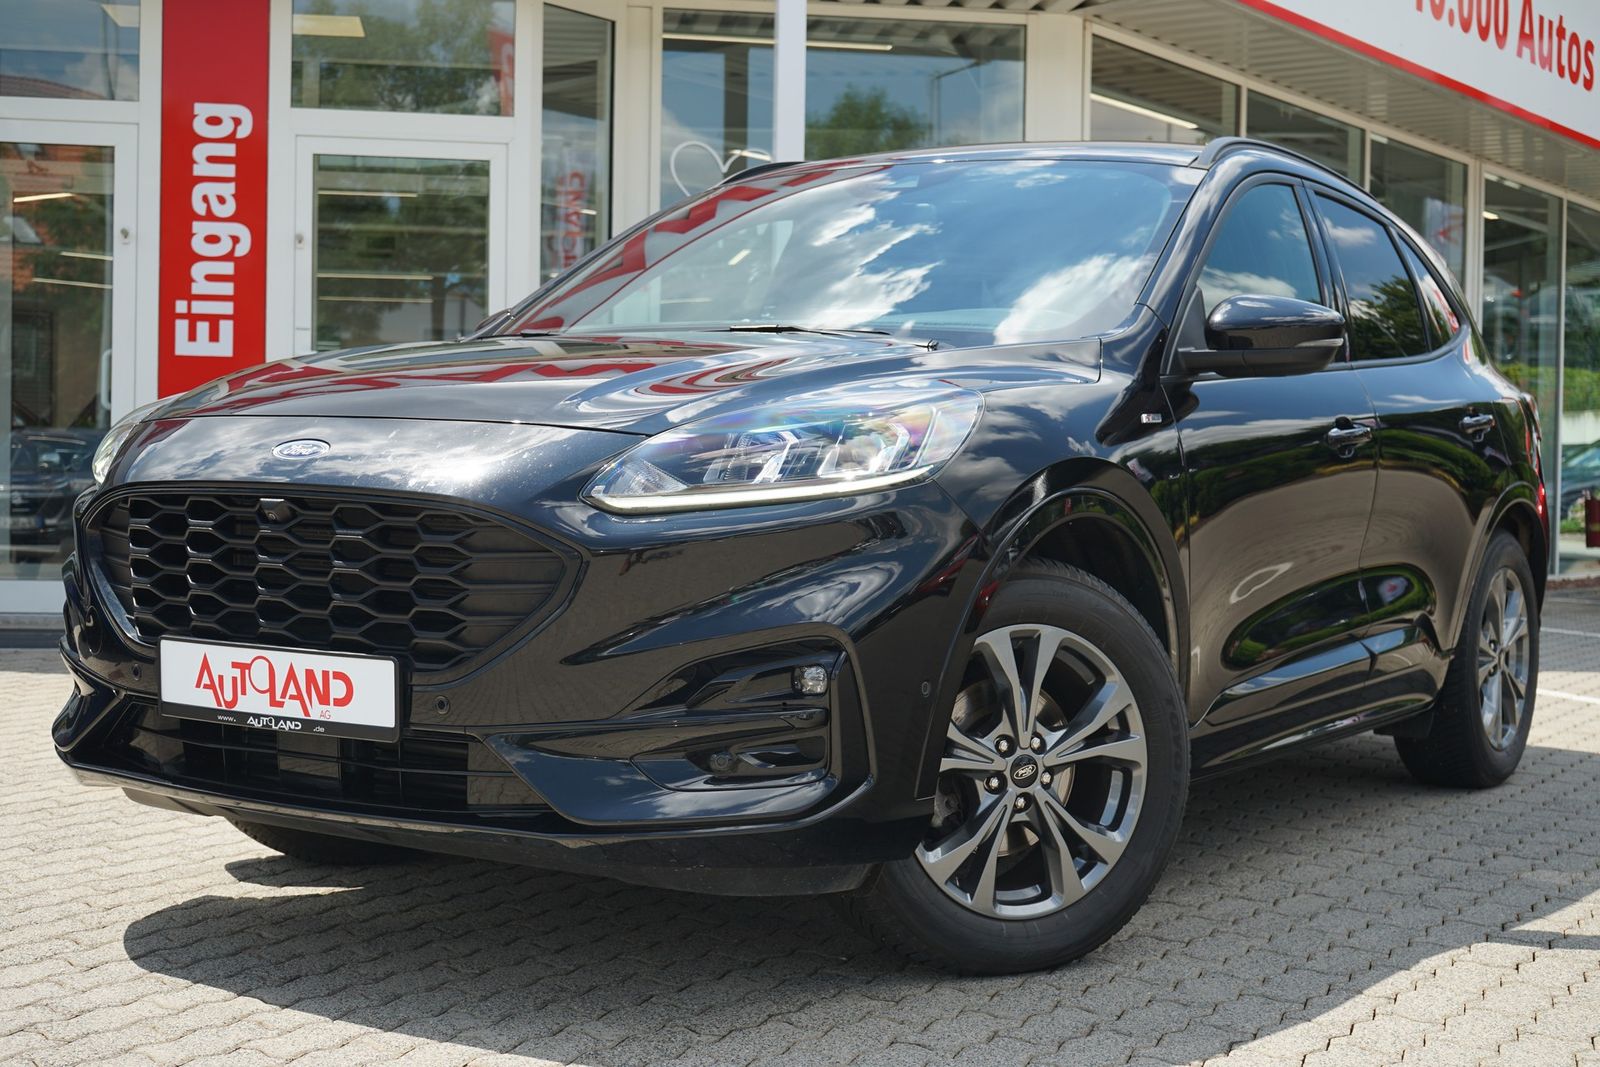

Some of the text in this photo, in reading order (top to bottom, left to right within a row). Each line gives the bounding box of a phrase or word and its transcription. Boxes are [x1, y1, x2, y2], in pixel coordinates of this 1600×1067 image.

[1415, 0, 1595, 92] .000 Autos
[174, 102, 254, 357] Eingang
[319, 709, 332, 720] AG
